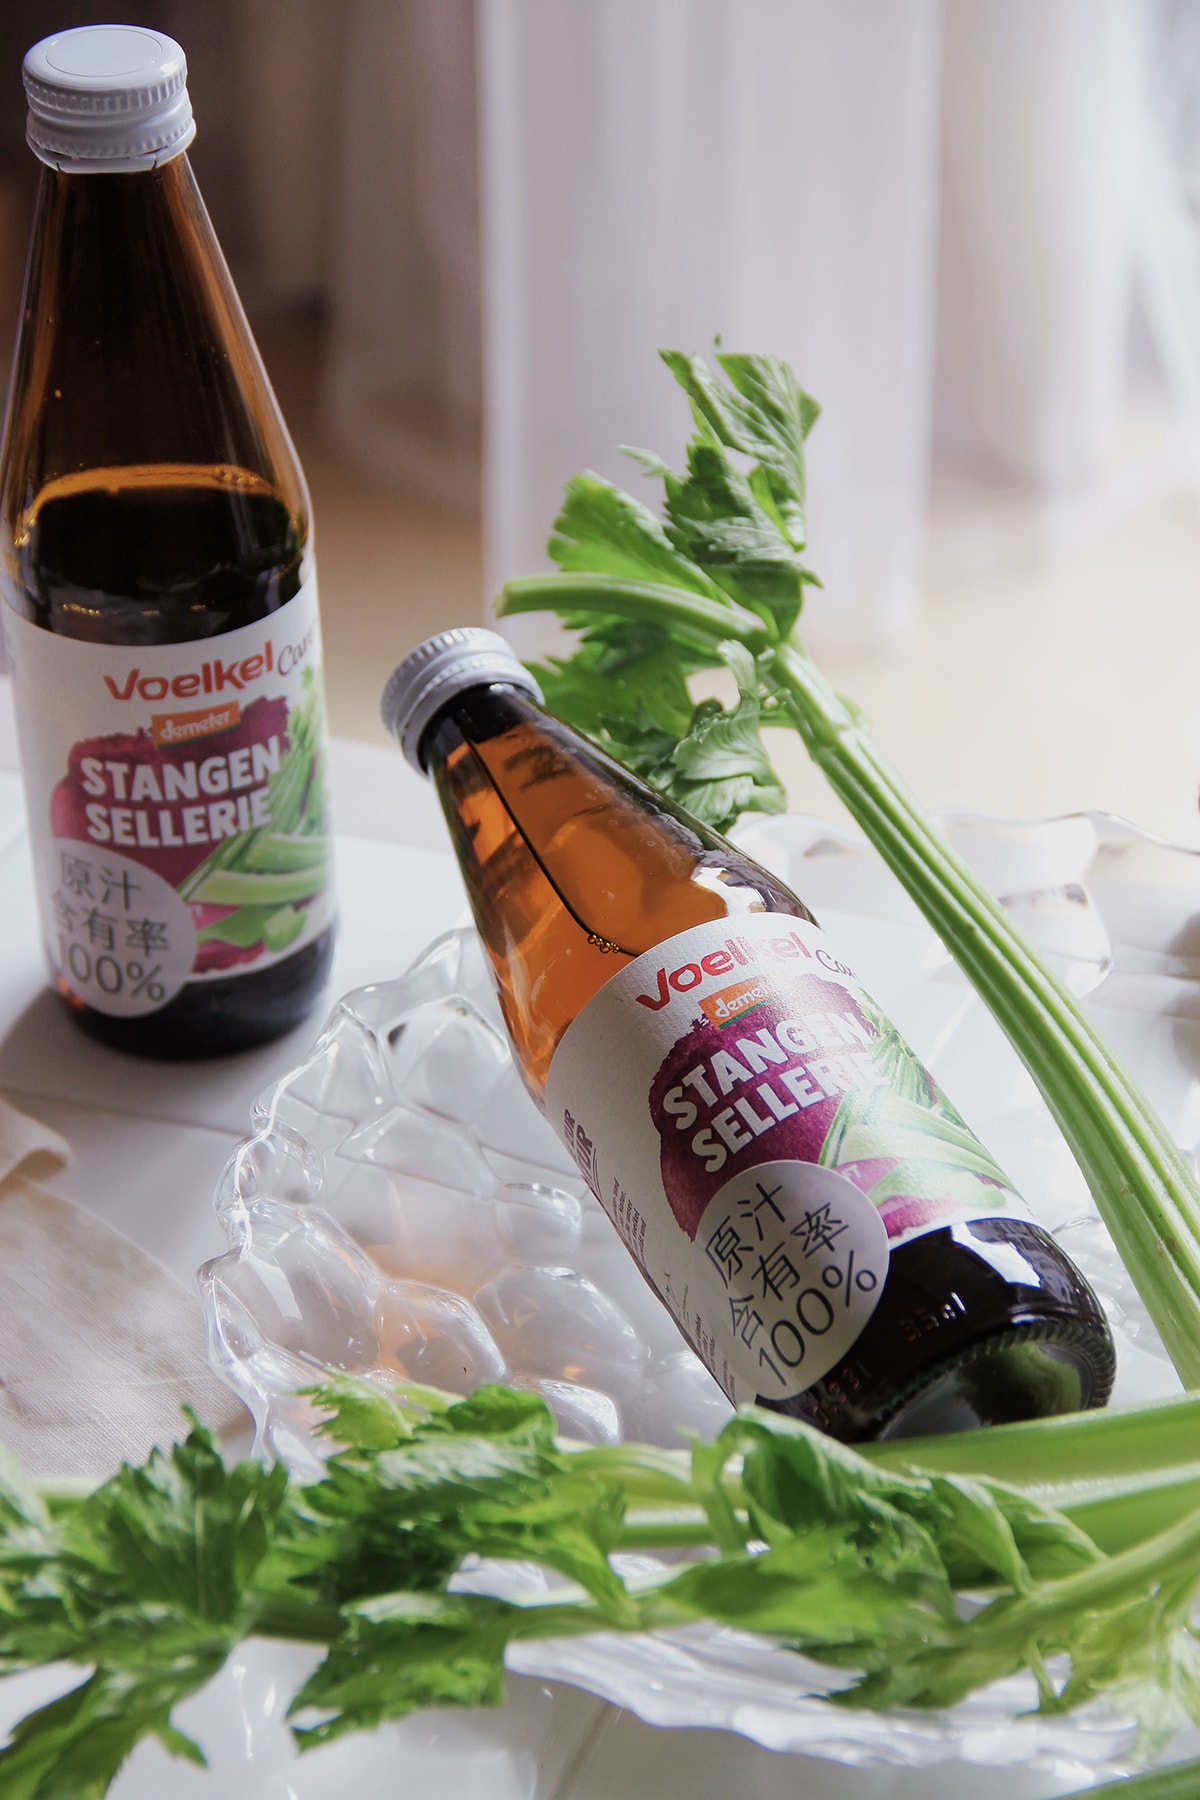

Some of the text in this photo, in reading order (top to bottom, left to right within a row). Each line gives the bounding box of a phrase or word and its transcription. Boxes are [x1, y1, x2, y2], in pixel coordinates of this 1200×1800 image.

[103, 640, 273, 701] Voelkel
[159, 711, 231, 741] demeter
[80, 736, 282, 802] STANGEN
[86, 787, 273, 847] SELLERIE
[60, 852, 142, 911] 原汁
[663, 1012, 874, 1130] STANGEN
[705, 1183, 785, 1289] 原汁
[729, 1202, 849, 1350] 含有率
[760, 1250, 877, 1387] 100%
